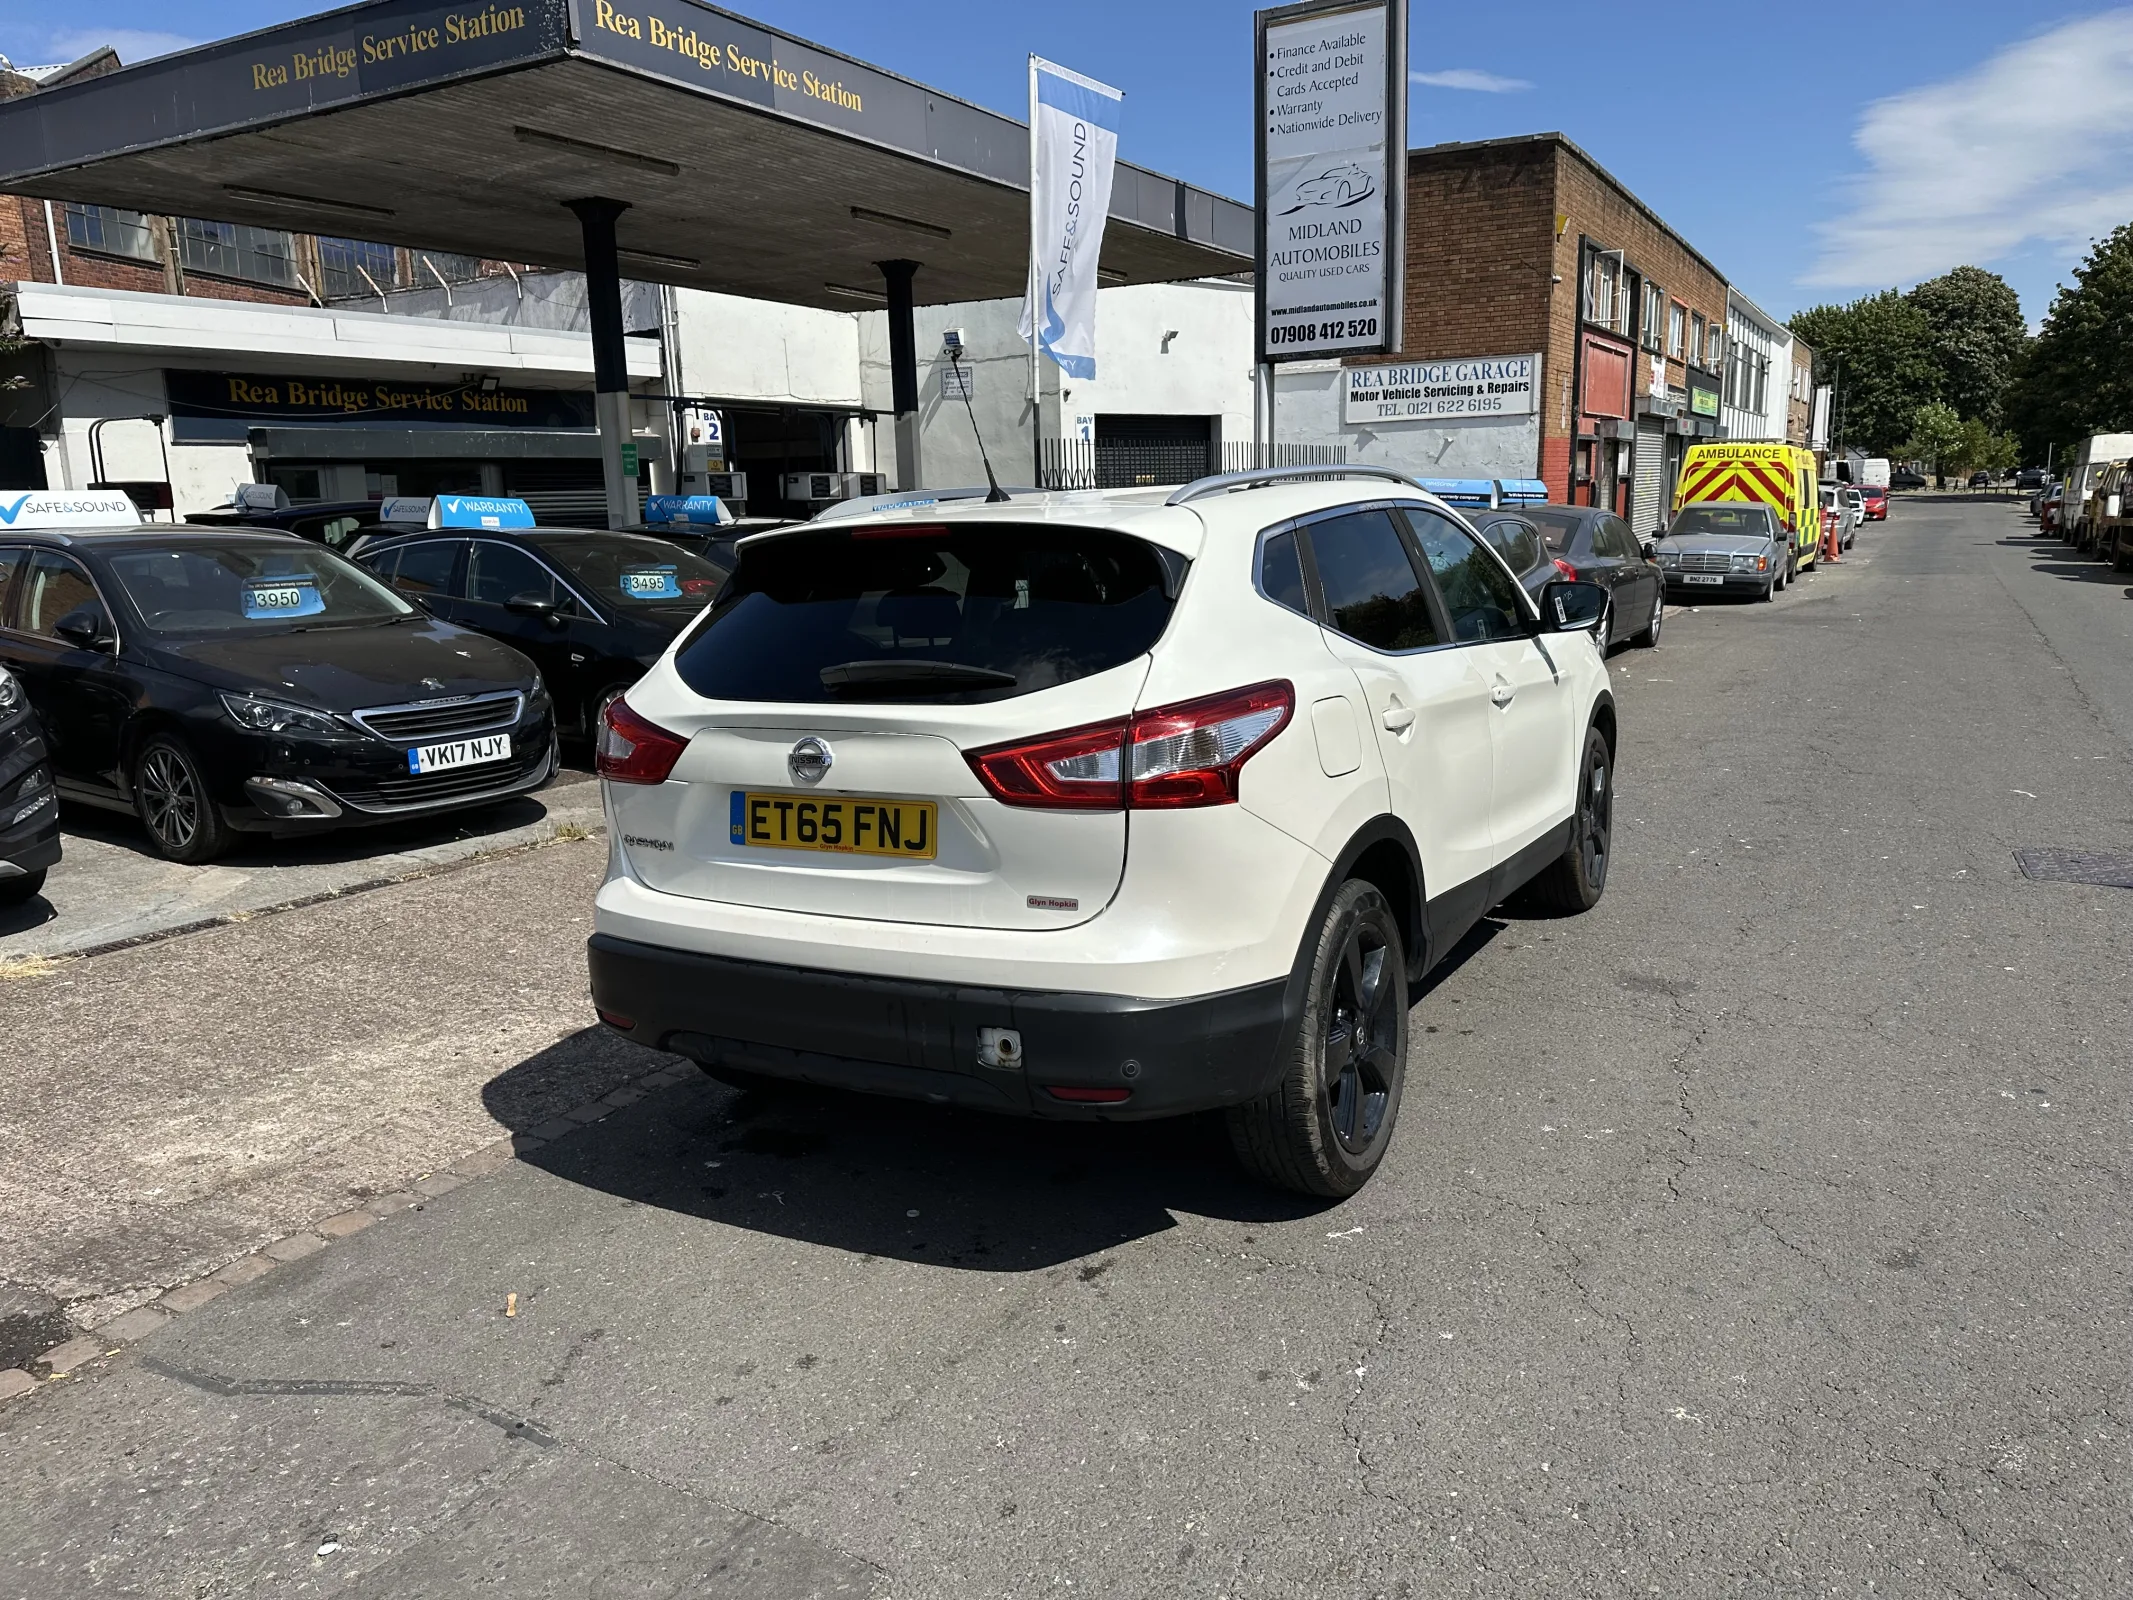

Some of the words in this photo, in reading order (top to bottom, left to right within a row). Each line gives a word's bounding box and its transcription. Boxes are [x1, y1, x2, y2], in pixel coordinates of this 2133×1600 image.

[252, 63, 288, 90] Rea
[292, 45, 358, 81] Bridge
[362, 24, 440, 65] Service
[445, 4, 526, 45] Station
[595, 0, 642, 40] Rea
[648, 15, 721, 71] Bridge
[726, 43, 798, 91] Service
[802, 70, 863, 112] Station
[1277, 44, 1316, 60] Finance
[1319, 33, 1366, 52] Available
[1277, 63, 1308, 78] Credit
[1311, 57, 1331, 72] and
[1334, 53, 1364, 69] Debit
[1277, 82, 1306, 97] Cards
[1309, 72, 1359, 92] Accepted
[1277, 100, 1323, 116] Warranty
[1277, 116, 1335, 135] Nationwide
[1338, 111, 1382, 126] Delivery
[1052, 121, 1087, 296] SAFE&SOUND
[1289, 218, 1362, 241] MIDLAND
[1270, 240, 1380, 267] AUTOMOBILES
[1279, 269, 1317, 282] QUALITY
[1319, 266, 1344, 278] USED
[1346, 263, 1370, 275] CARS
[1271, 298, 1378, 316] www.midlandautomobiles.co.uk
[1270, 323, 1316, 344] 07908
[1319, 320, 1344, 340] 412
[1347, 318, 1377, 338] 520
[1352, 371, 1383, 388] REA
[1388, 365, 1451, 385] BRIDGE
[1455, 360, 1529, 382] GARAGE
[227, 378, 279, 404] Rea
[286, 381, 369, 413] Bridge
[375, 385, 453, 411] Service
[461, 390, 529, 413] Station
[1350, 390, 1380, 403] Motor
[1382, 387, 1421, 401] Vehicle
[1423, 383, 1474, 400] Servicing
[1476, 385, 1485, 395] &
[1487, 381, 1530, 395] Repairs
[1377, 403, 1404, 417] TEL.
[1407, 401, 1433, 415] 0121
[1437, 400, 1464, 413] 622
[1467, 397, 1502, 412] 6195
[708, 422, 719, 440] 2
[1076, 416, 1093, 425] BAY
[1081, 425, 1089, 442] 1
[1697, 448, 1781, 459] AMBULANCE
[25, 500, 127, 514] SAFE&SOUND
[461, 500, 524, 514] WARRANTY
[663, 499, 713, 512] WARRANTY
[425, 743, 466, 767] VK17
[470, 736, 503, 759] NJY
[791, 754, 826, 765] NISSAN
[732, 825, 743, 836] GB
[751, 800, 842, 844] ET65
[854, 805, 927, 851] FNJ
[819, 843, 833, 851] Glyn
[833, 845, 854, 853] Hopkin
[1028, 898, 1047, 906] Glyn
[1048, 899, 1077, 908] Hopkin
